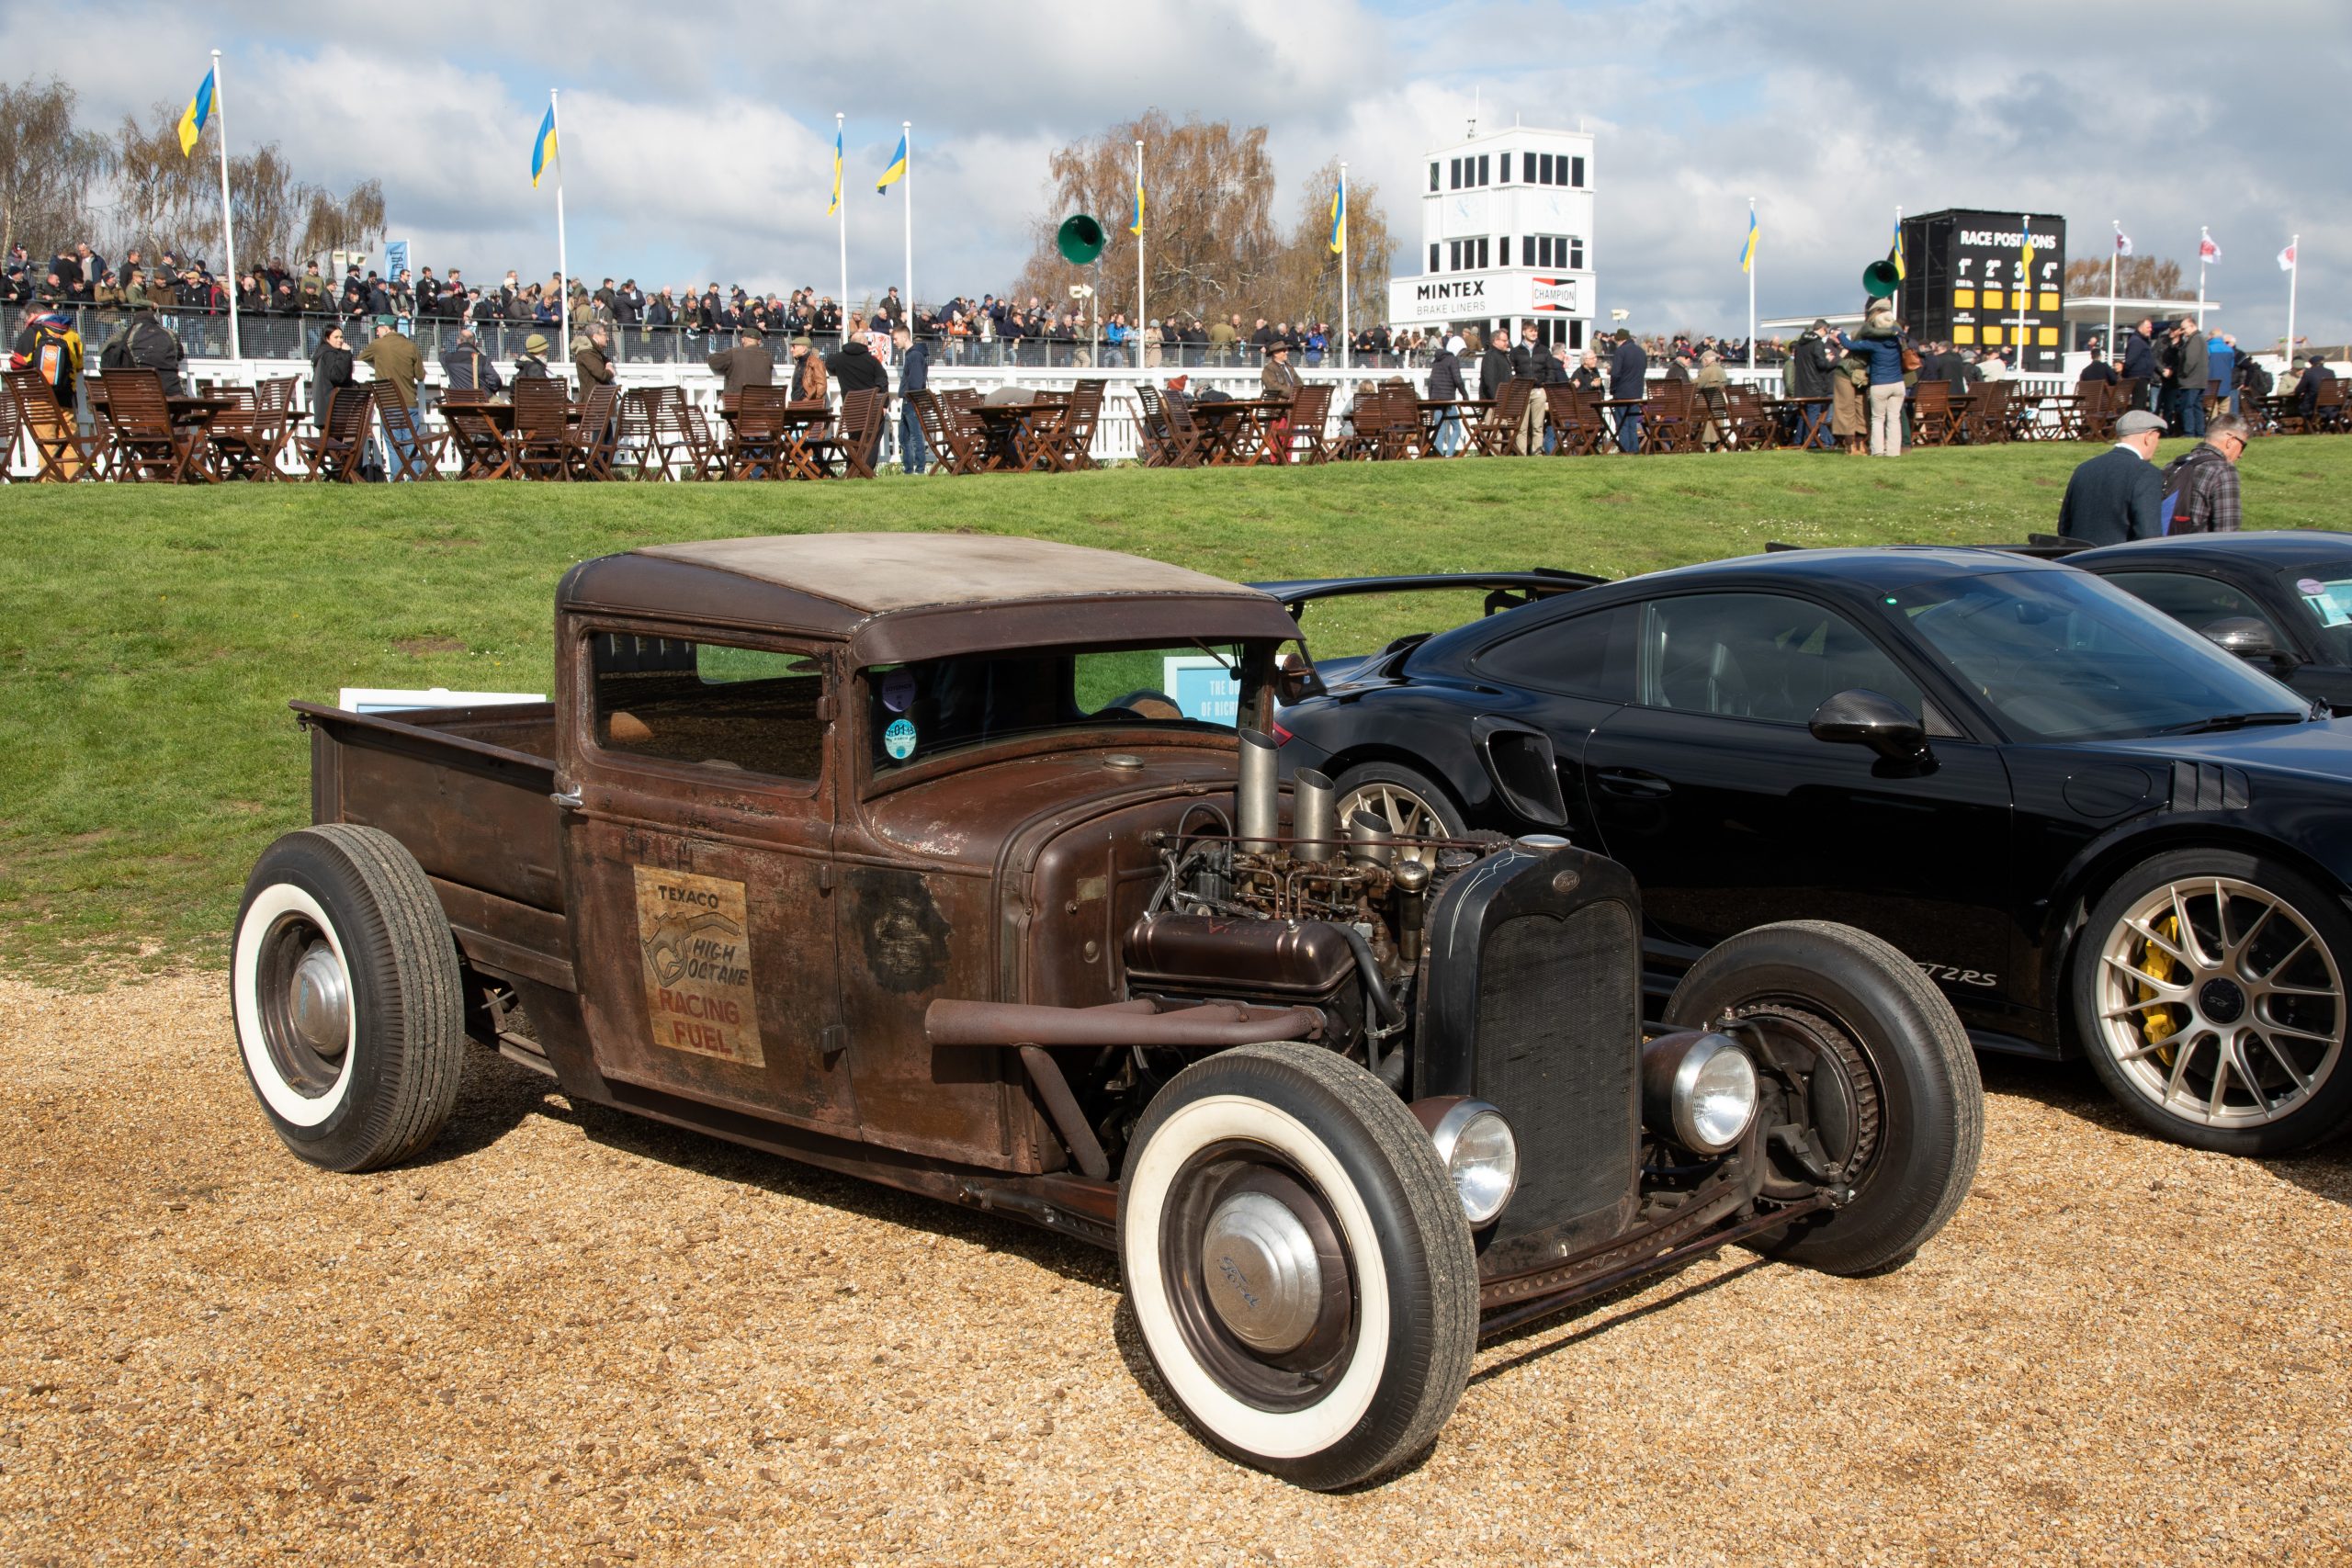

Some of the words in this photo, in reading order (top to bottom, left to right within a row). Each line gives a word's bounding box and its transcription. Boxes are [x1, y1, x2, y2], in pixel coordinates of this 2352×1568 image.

[1961, 231, 1993, 246] RACE
[1994, 231, 2056, 249] POSITONS
[1417, 280, 1485, 300] MINTEX
[1533, 288, 1575, 301] CHAMPION
[1417, 304, 1448, 316] BRAKE
[1452, 301, 1486, 313] LINERS
[1209, 680, 1227, 696] THE
[1201, 701, 1212, 716] OF
[1215, 701, 1238, 716] RICH
[658, 885, 719, 909] TEXACO
[693, 938, 736, 963] HIGH
[688, 958, 750, 987] OCTANE
[659, 987, 741, 1025] RACING
[673, 1021, 733, 1055] FUEL
